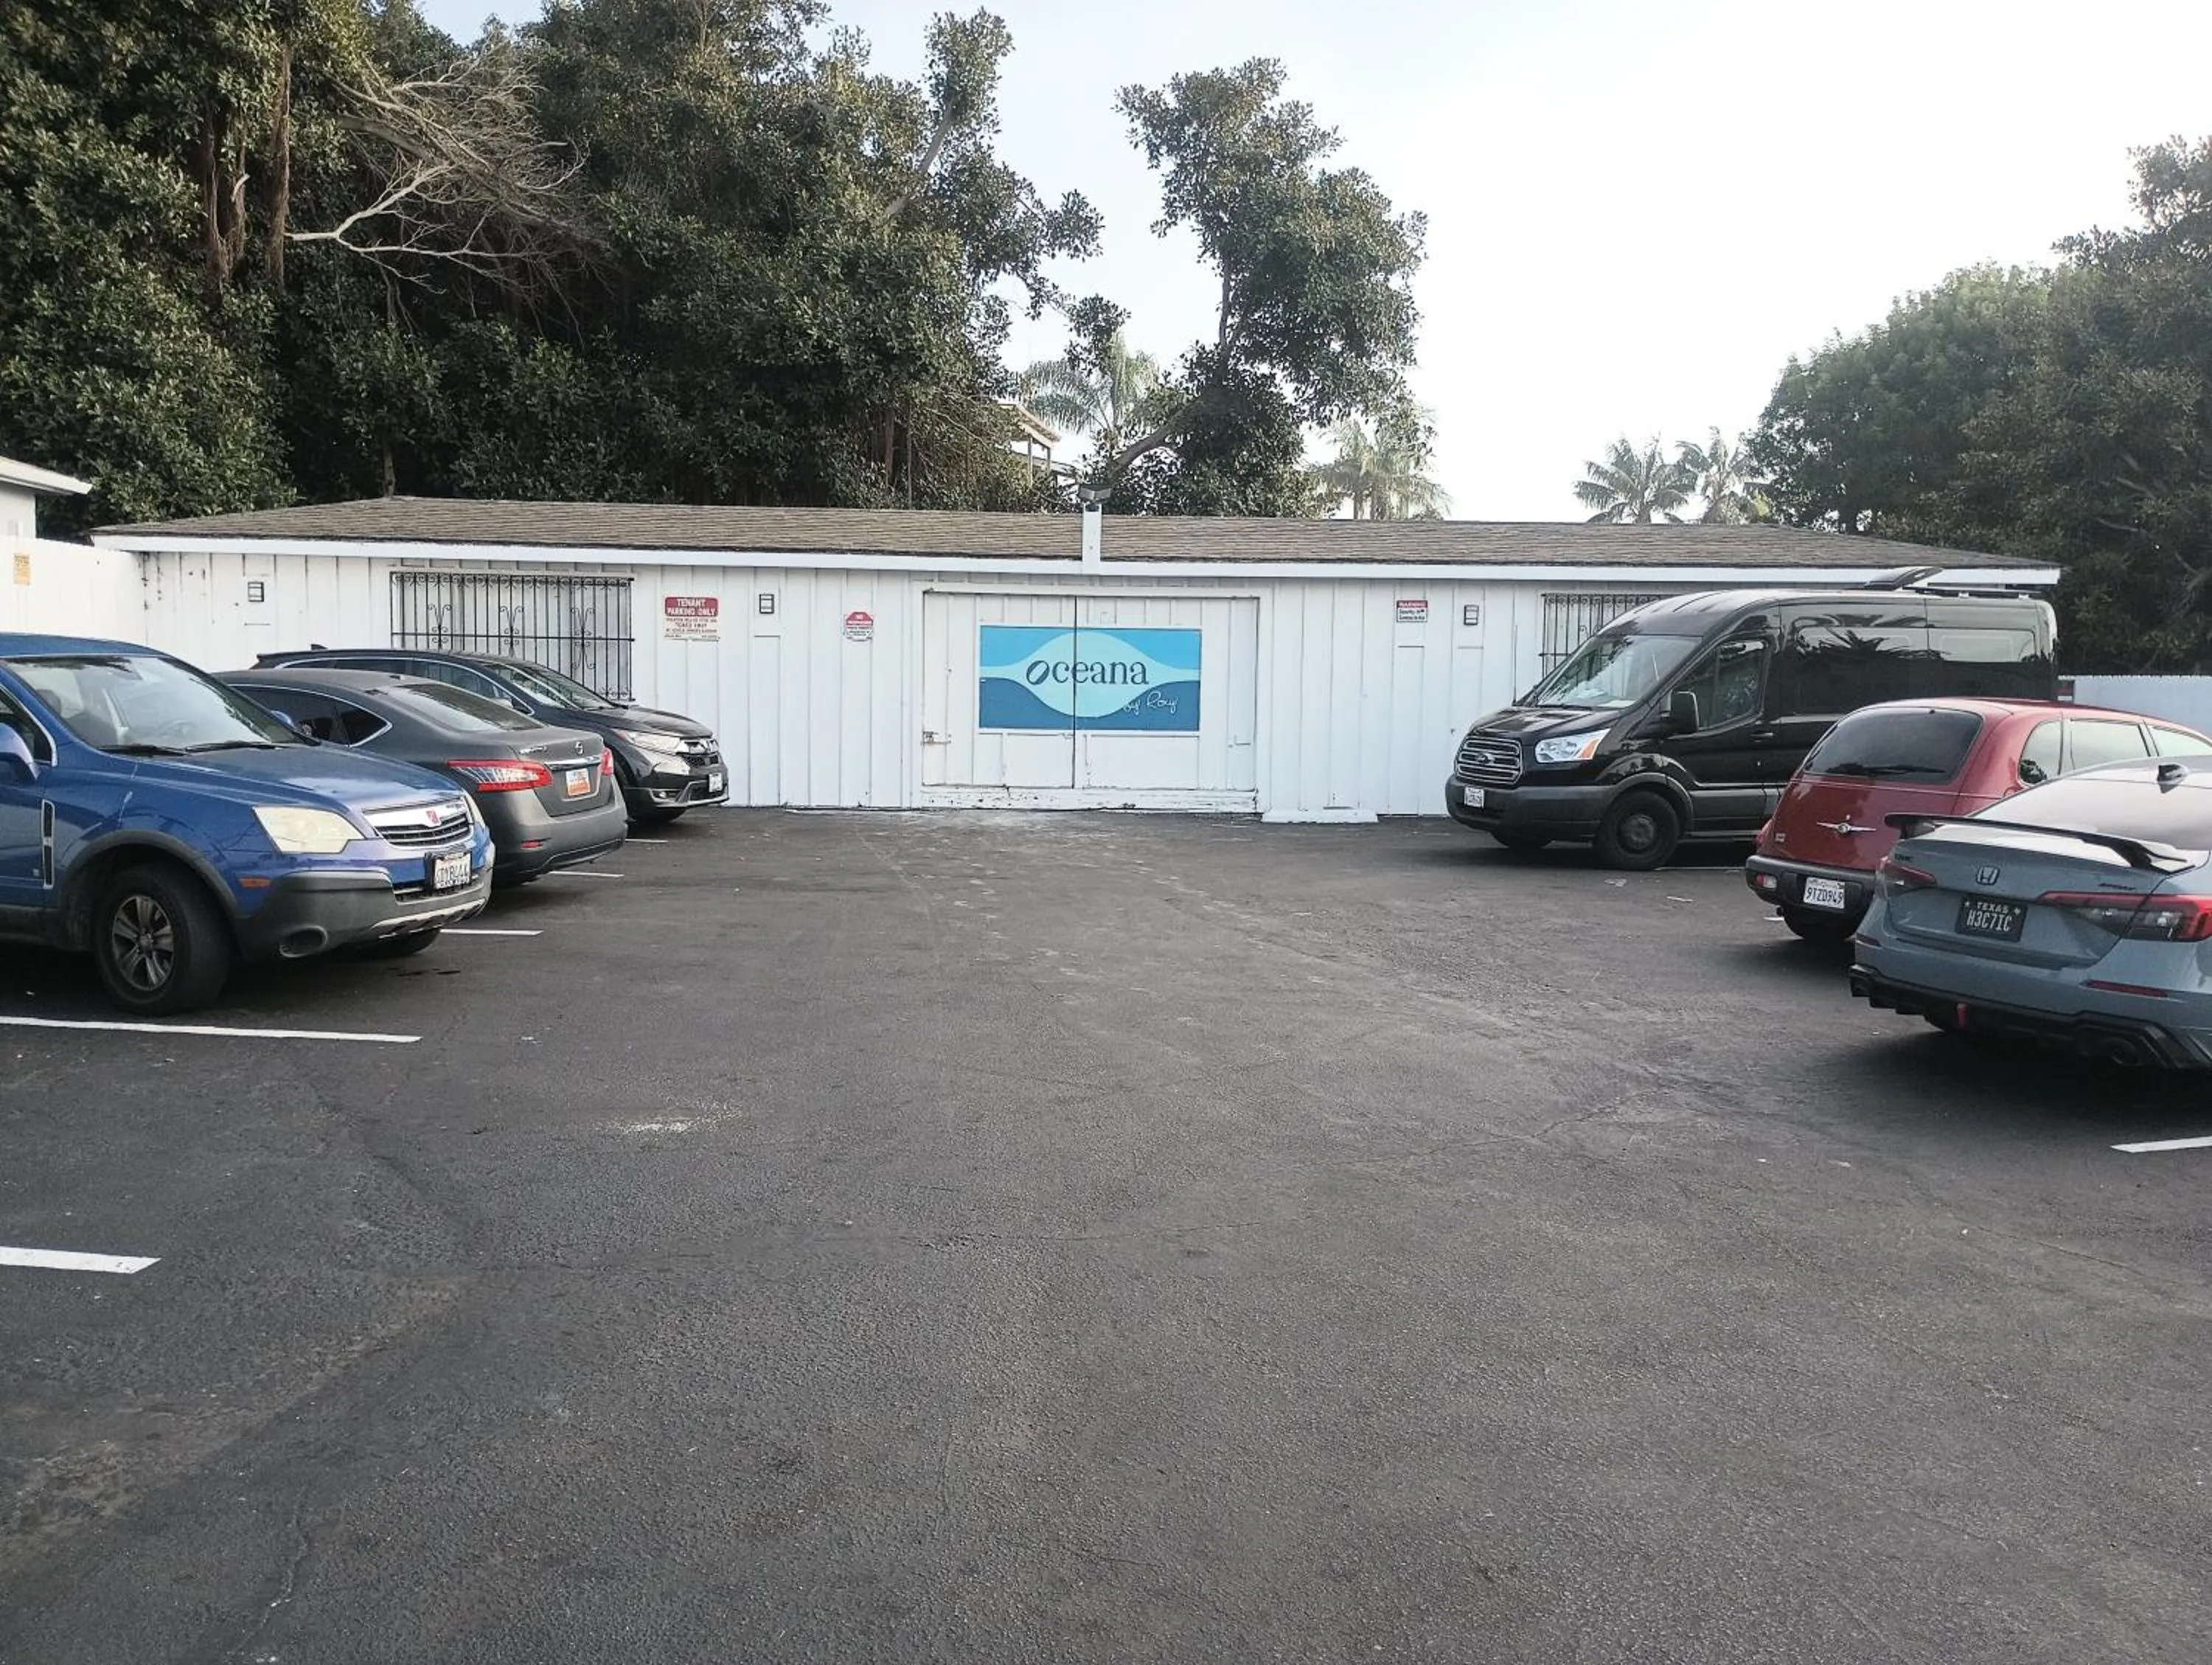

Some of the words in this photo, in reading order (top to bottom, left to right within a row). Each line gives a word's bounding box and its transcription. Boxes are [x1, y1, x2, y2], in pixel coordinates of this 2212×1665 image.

[677, 598, 706, 607] TENANT
[666, 607, 695, 616] PARKING
[697, 608, 715, 616] ONLY
[1977, 901, 2008, 914] TEXAS
